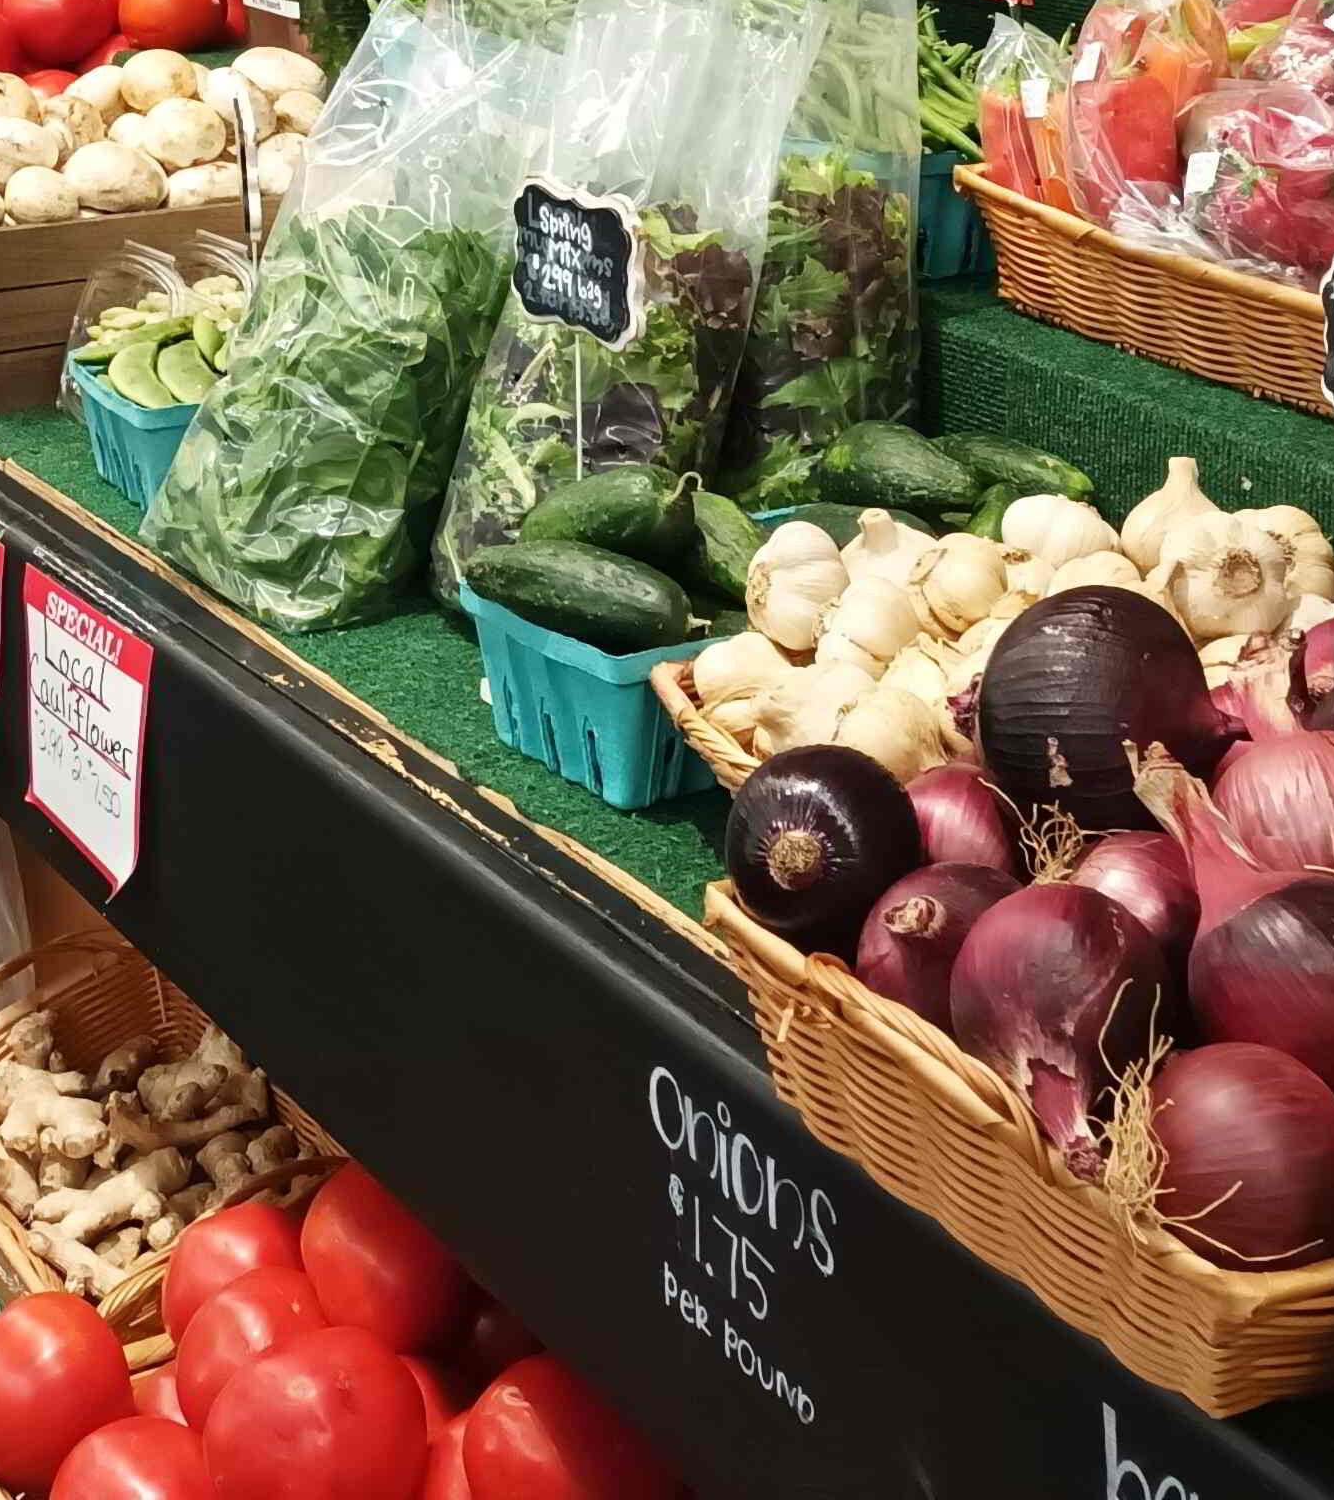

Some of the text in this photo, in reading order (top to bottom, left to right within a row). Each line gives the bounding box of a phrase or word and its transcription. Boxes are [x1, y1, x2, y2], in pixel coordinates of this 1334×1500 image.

[539, 204, 593, 253] Spring
[44, 616, 107, 708] Local
[45, 590, 124, 664] SPECIAL!
[30, 652, 133, 770] Cauliflower
[649, 1065, 838, 1277] Onions
